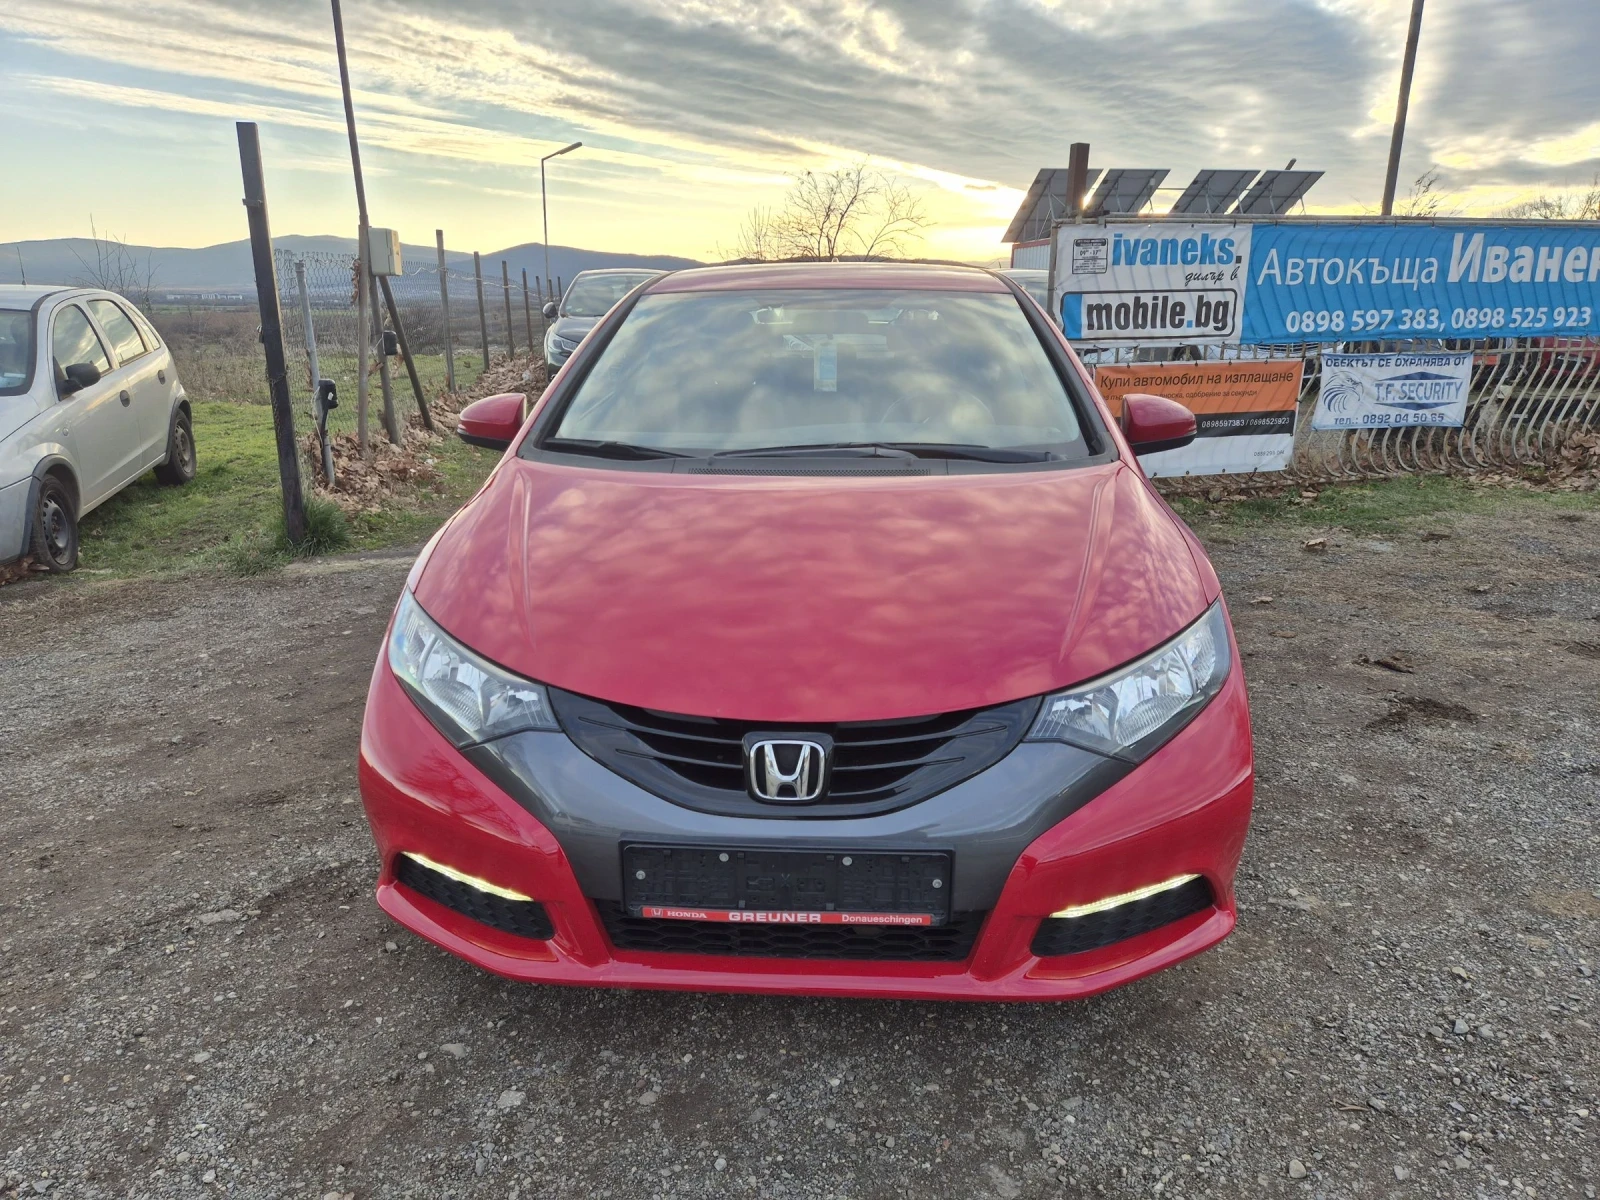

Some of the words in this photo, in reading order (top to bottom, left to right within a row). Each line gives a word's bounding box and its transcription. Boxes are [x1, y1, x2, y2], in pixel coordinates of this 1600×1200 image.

[1184, 271, 1226, 287] дилър
[1256, 248, 1439, 291] Автокъща
[1086, 294, 1230, 332] mobile.bg
[1286, 310, 1345, 333] 0898
[1351, 309, 1394, 331] 597
[1398, 308, 1446, 332] 383,
[1451, 307, 1505, 330] 0898
[1509, 306, 1548, 328] 525
[1553, 306, 1592, 327] 923
[1325, 358, 1376, 368] ОБЕКТЪТ
[1378, 357, 1392, 368] СЕ
[1395, 357, 1450, 367] ОХРАНЯВА
[1454, 356, 1467, 366] ОТ
[1100, 376, 1130, 390] Купи
[1133, 373, 1203, 388] автомобил
[1206, 374, 1222, 385] на
[1225, 371, 1294, 385] изплащане
[1397, 381, 1464, 401] SECURITY
[1362, 414, 1391, 424] 0892
[1394, 413, 1409, 423] 04
[1413, 413, 1427, 423] 50
[667, 910, 708, 919] HONDA
[728, 911, 822, 923] GREUNER
[841, 913, 923, 924] Donaueschingen
